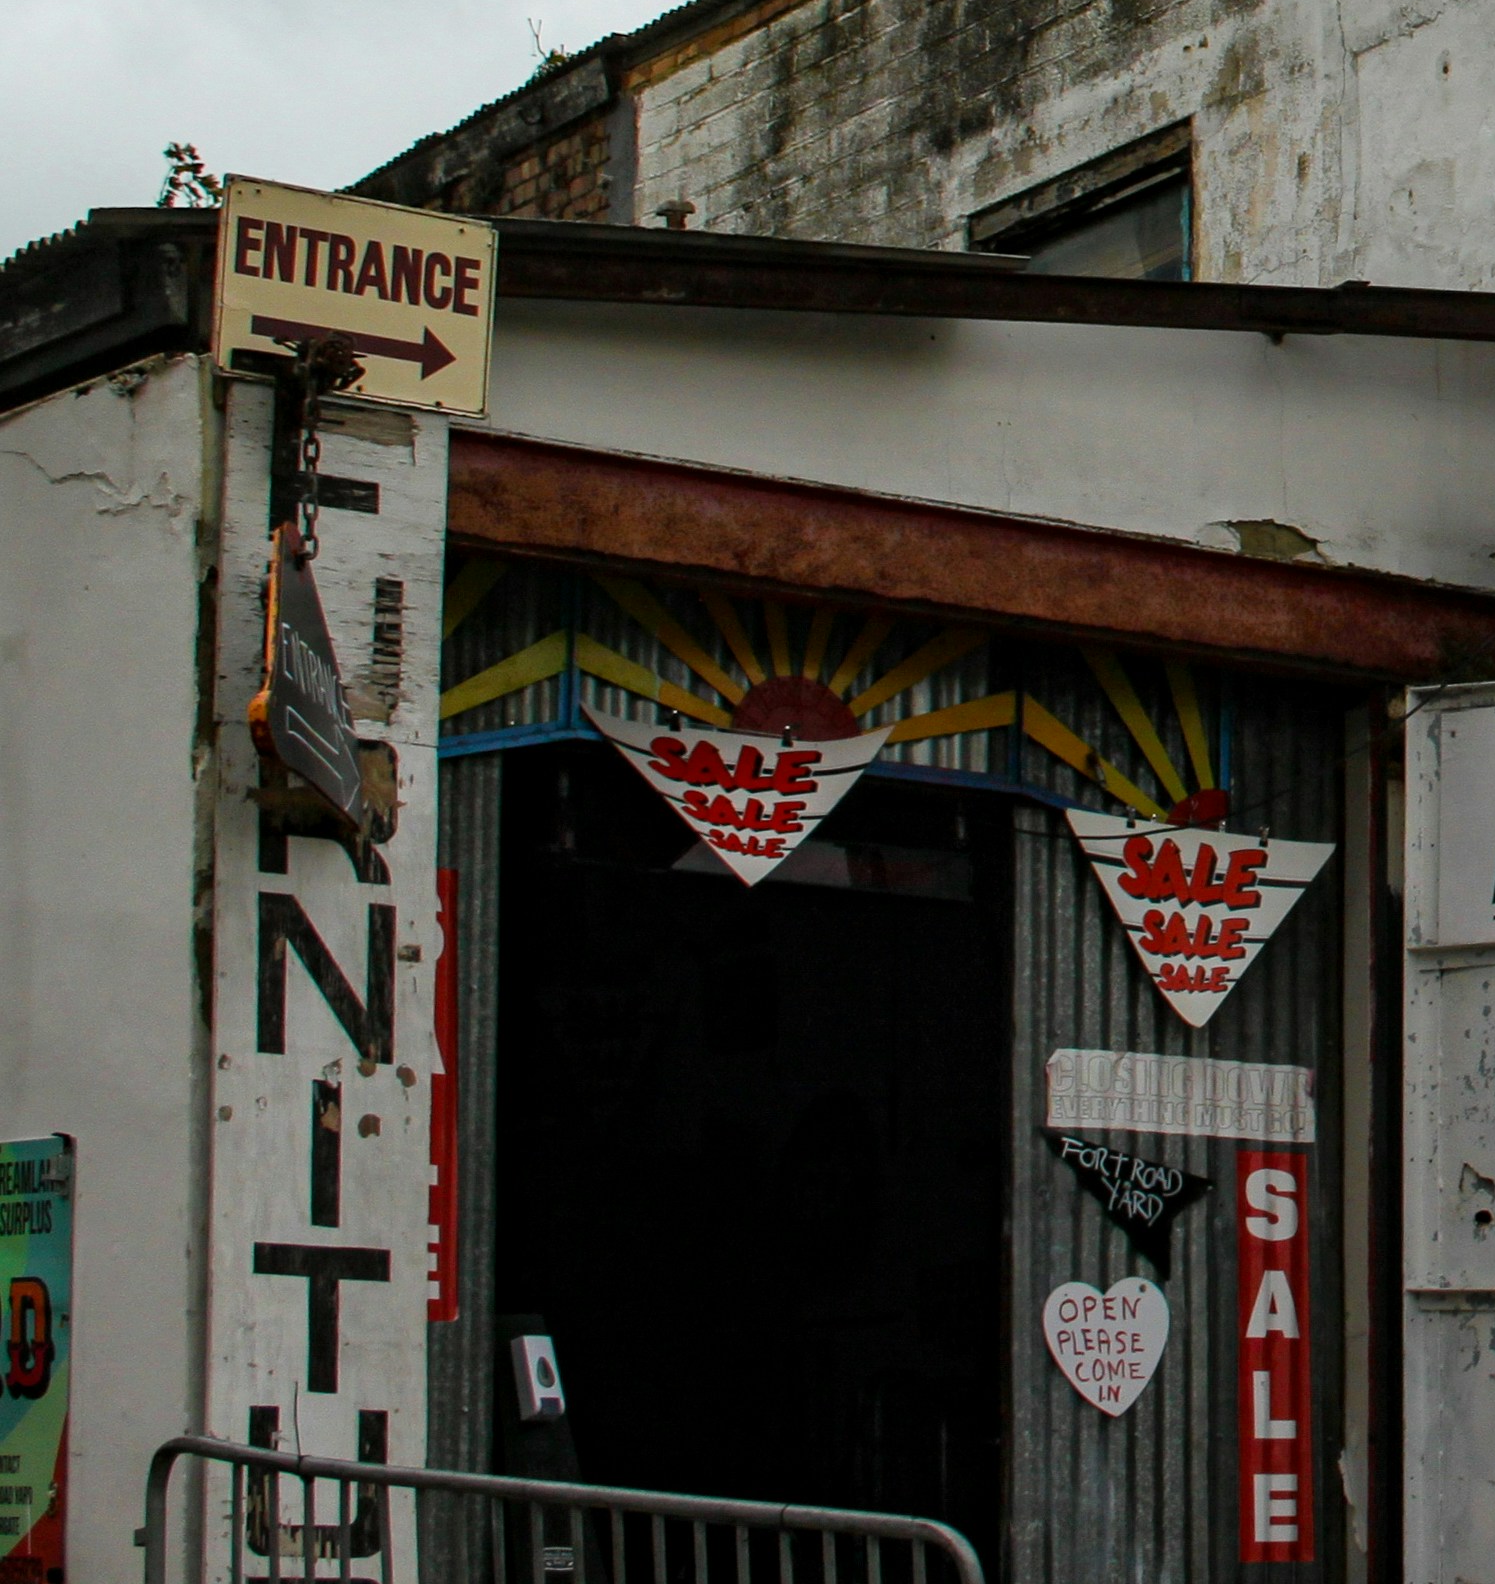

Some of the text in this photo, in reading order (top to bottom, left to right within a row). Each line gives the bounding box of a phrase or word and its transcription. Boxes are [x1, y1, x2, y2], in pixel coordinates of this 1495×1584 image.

[234, 215, 482, 317] ENTRANCE
[648, 736, 822, 796] SALE
[682, 790, 807, 834] SALE
[709, 828, 787, 859] SALE
[1117, 836, 1269, 911] SALE
[1138, 909, 1250, 961] SALE
[1157, 963, 1230, 993] SALE
[1051, 1095, 1189, 1126] EVERYTHING
[1194, 1102, 1265, 1132] MUST
[1061, 1137, 1184, 1198] FORT ROAD
[1101, 1176, 1164, 1228] YARD
[1059, 1295, 1142, 1324] OPEN
[1056, 1328, 1146, 1356] PLEASE
[1245, 1168, 1301, 1543] SALE
[1075, 1358, 1146, 1382] COME
